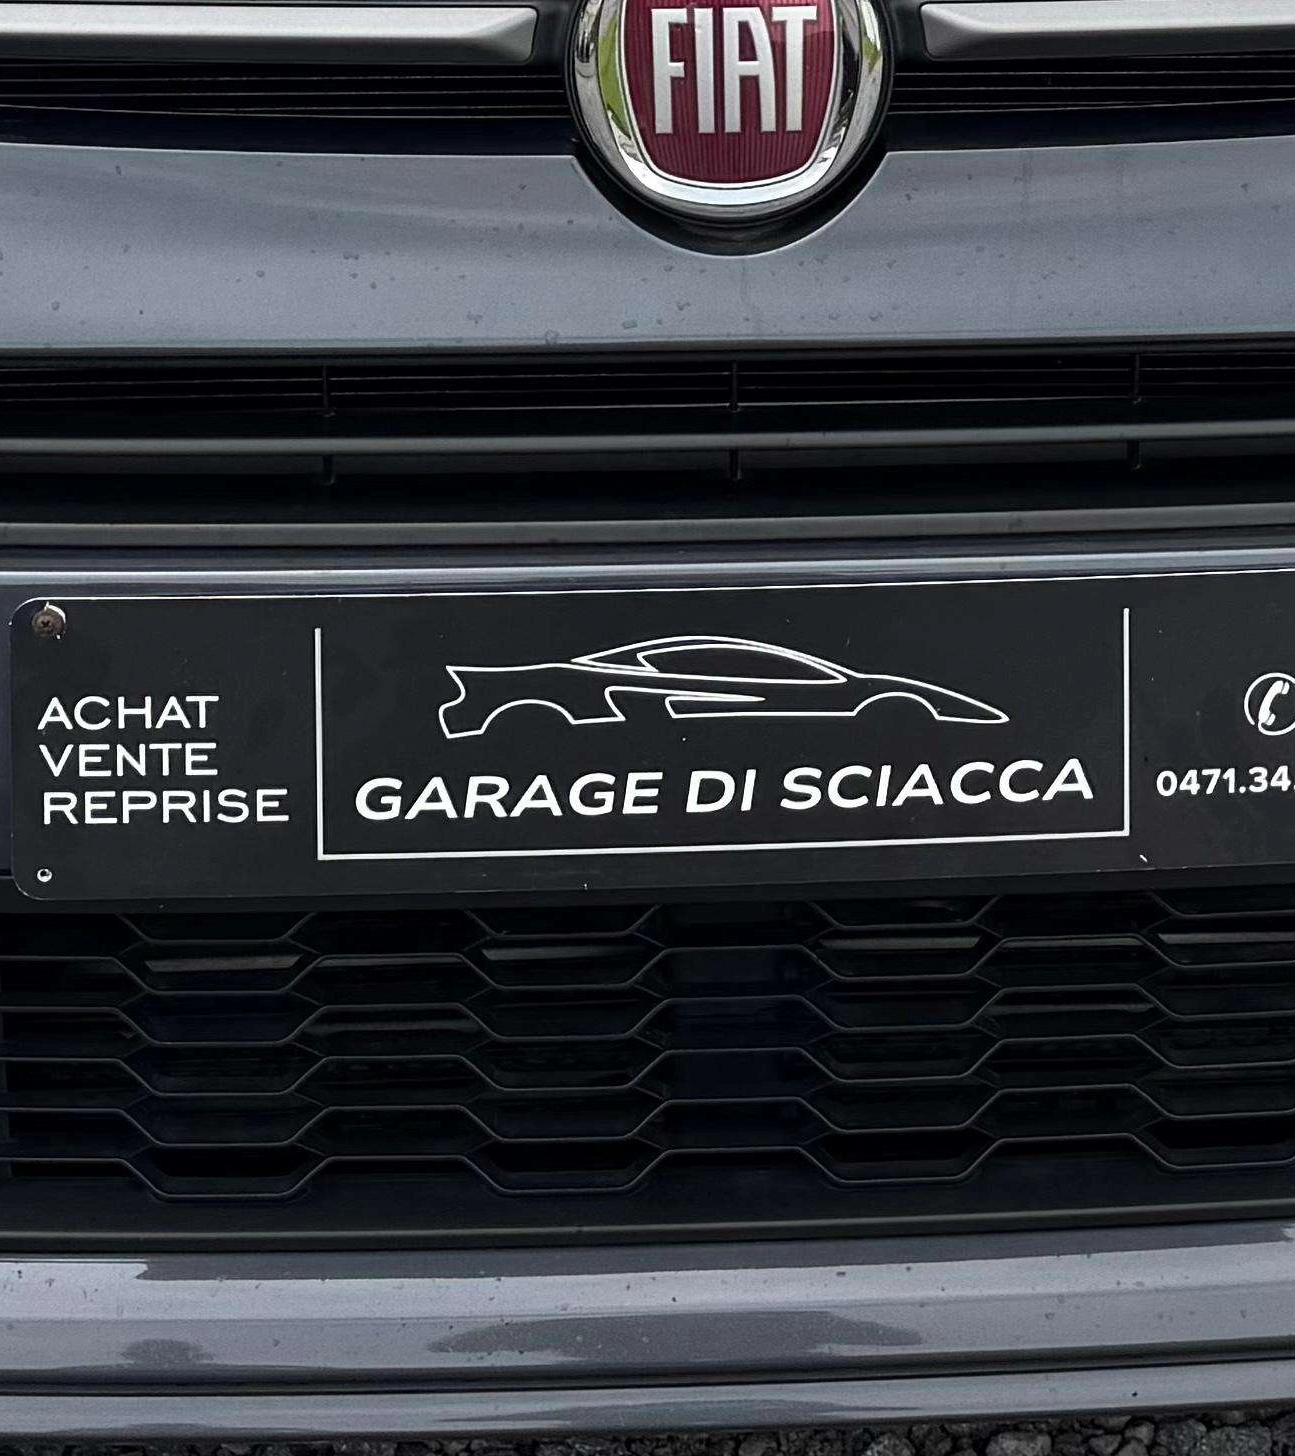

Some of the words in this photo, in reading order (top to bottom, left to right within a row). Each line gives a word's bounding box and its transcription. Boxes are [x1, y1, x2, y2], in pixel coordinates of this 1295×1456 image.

[651, 5, 818, 134] FIAT
[37, 695, 220, 731] ACHAT
[38, 742, 219, 778] VENTE
[43, 788, 290, 825] REPRISE
[355, 771, 664, 821] GARAGE
[685, 768, 757, 813] DI
[780, 757, 1094, 811] SCIACCA
